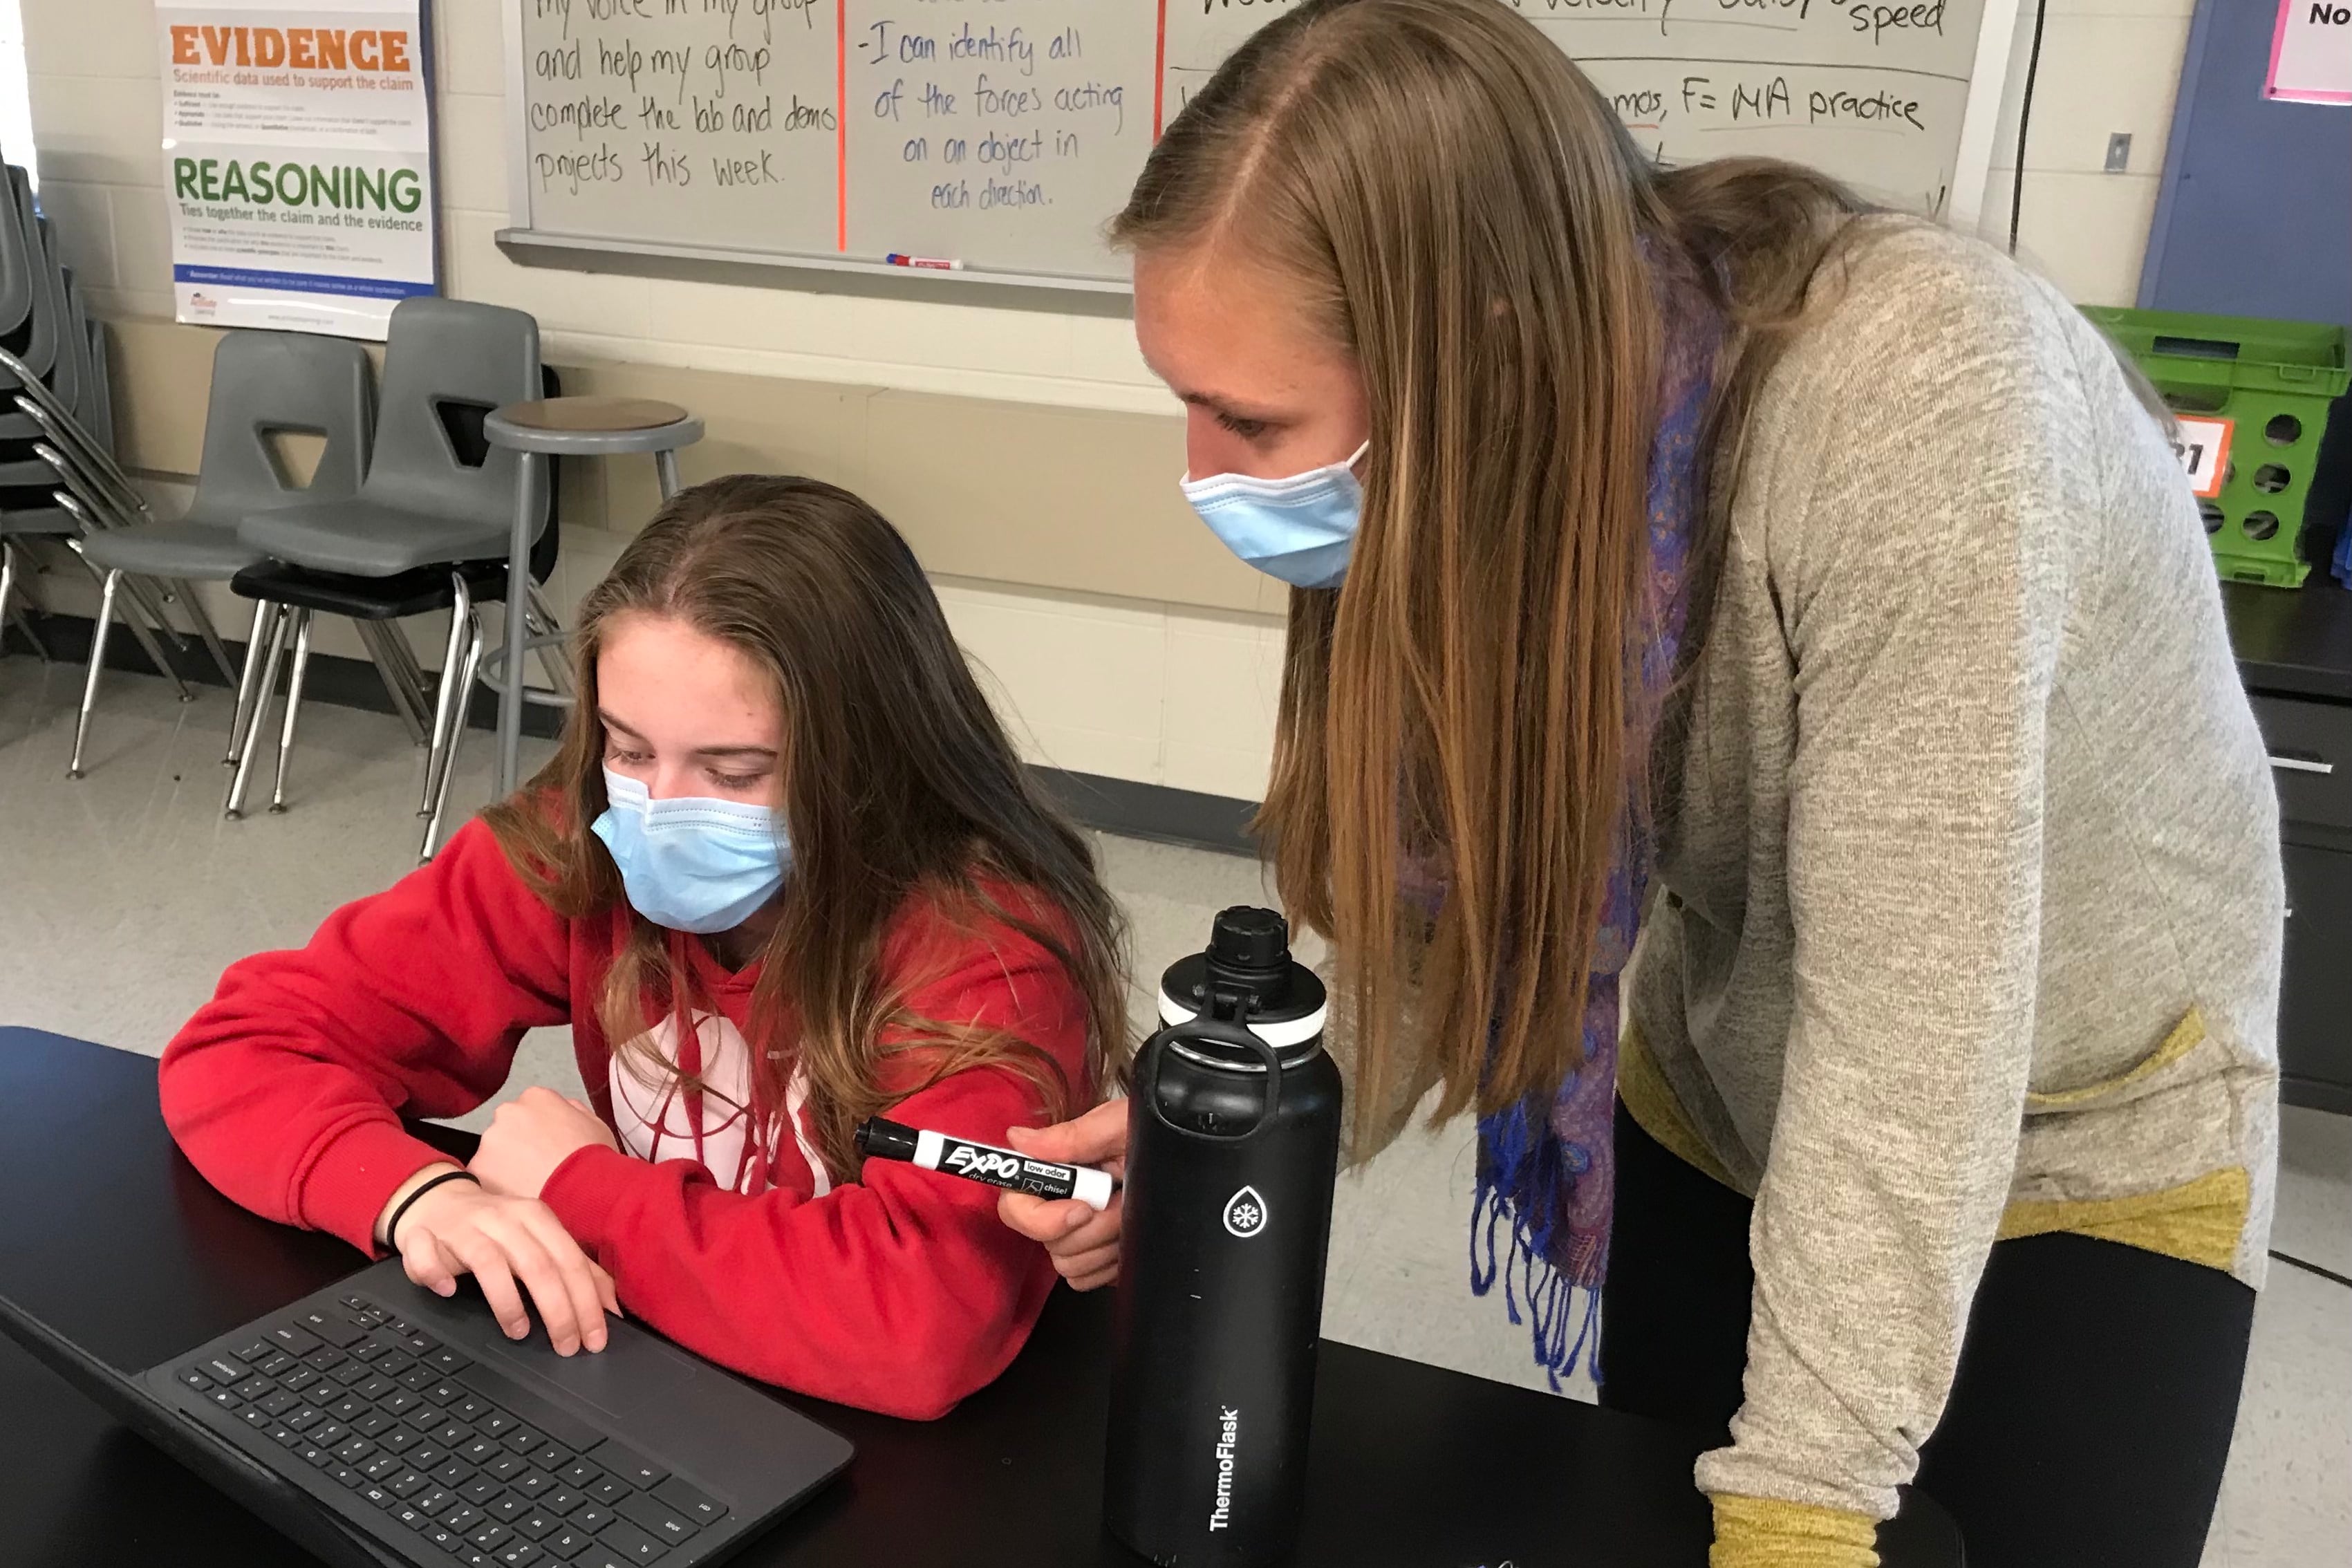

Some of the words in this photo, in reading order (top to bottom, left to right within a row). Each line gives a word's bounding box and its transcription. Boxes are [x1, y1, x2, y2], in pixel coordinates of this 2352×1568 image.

[753, 0, 816, 45] group
[1849, 3, 1943, 46] speed
[170, 26, 410, 72] EVIDENCE
[536, 38, 581, 81] and
[599, 38, 642, 93] help
[651, 46, 691, 104] my
[705, 44, 771, 98] group
[899, 34, 935, 63] can
[949, 22, 1033, 76] identify
[1049, 26, 1081, 59] all
[174, 69, 230, 84] Scientific
[234, 71, 259, 85] data
[263, 73, 290, 86] used
[293, 74, 305, 87] to
[308, 76, 353, 91] support
[356, 75, 375, 90] the
[380, 76, 413, 91] claim
[531, 95, 627, 141] complete
[639, 96, 681, 131] the
[693, 95, 724, 133] lab
[732, 95, 772, 133] and
[875, 78, 904, 122] of
[918, 82, 960, 117] the
[974, 73, 1041, 118] forces
[1054, 83, 1123, 136] acting
[1605, 91, 1668, 122] mos,
[1733, 77, 1790, 120] MA
[1809, 89, 1925, 131] practice
[535, 142, 622, 196] projects
[642, 142, 691, 186] this
[903, 138, 928, 162] on
[944, 139, 966, 164] an
[978, 129, 1043, 175] object
[1056, 129, 1078, 158] in
[174, 158, 422, 214] REASONING
[931, 179, 969, 209] each
[179, 203, 203, 217] Ties
[206, 205, 254, 221] together
[257, 209, 277, 222] the
[281, 209, 313, 224] claim
[318, 213, 339, 226] and
[344, 214, 364, 227] the
[368, 216, 423, 232] evidence
[945, 1146, 1020, 1179] EXPO
[1027, 1161, 1043, 1173] low
[1045, 1168, 1066, 1179] odor
[1044, 1184, 1067, 1195] chisel
[1210, 1408, 1238, 1532] ThermoFlask
